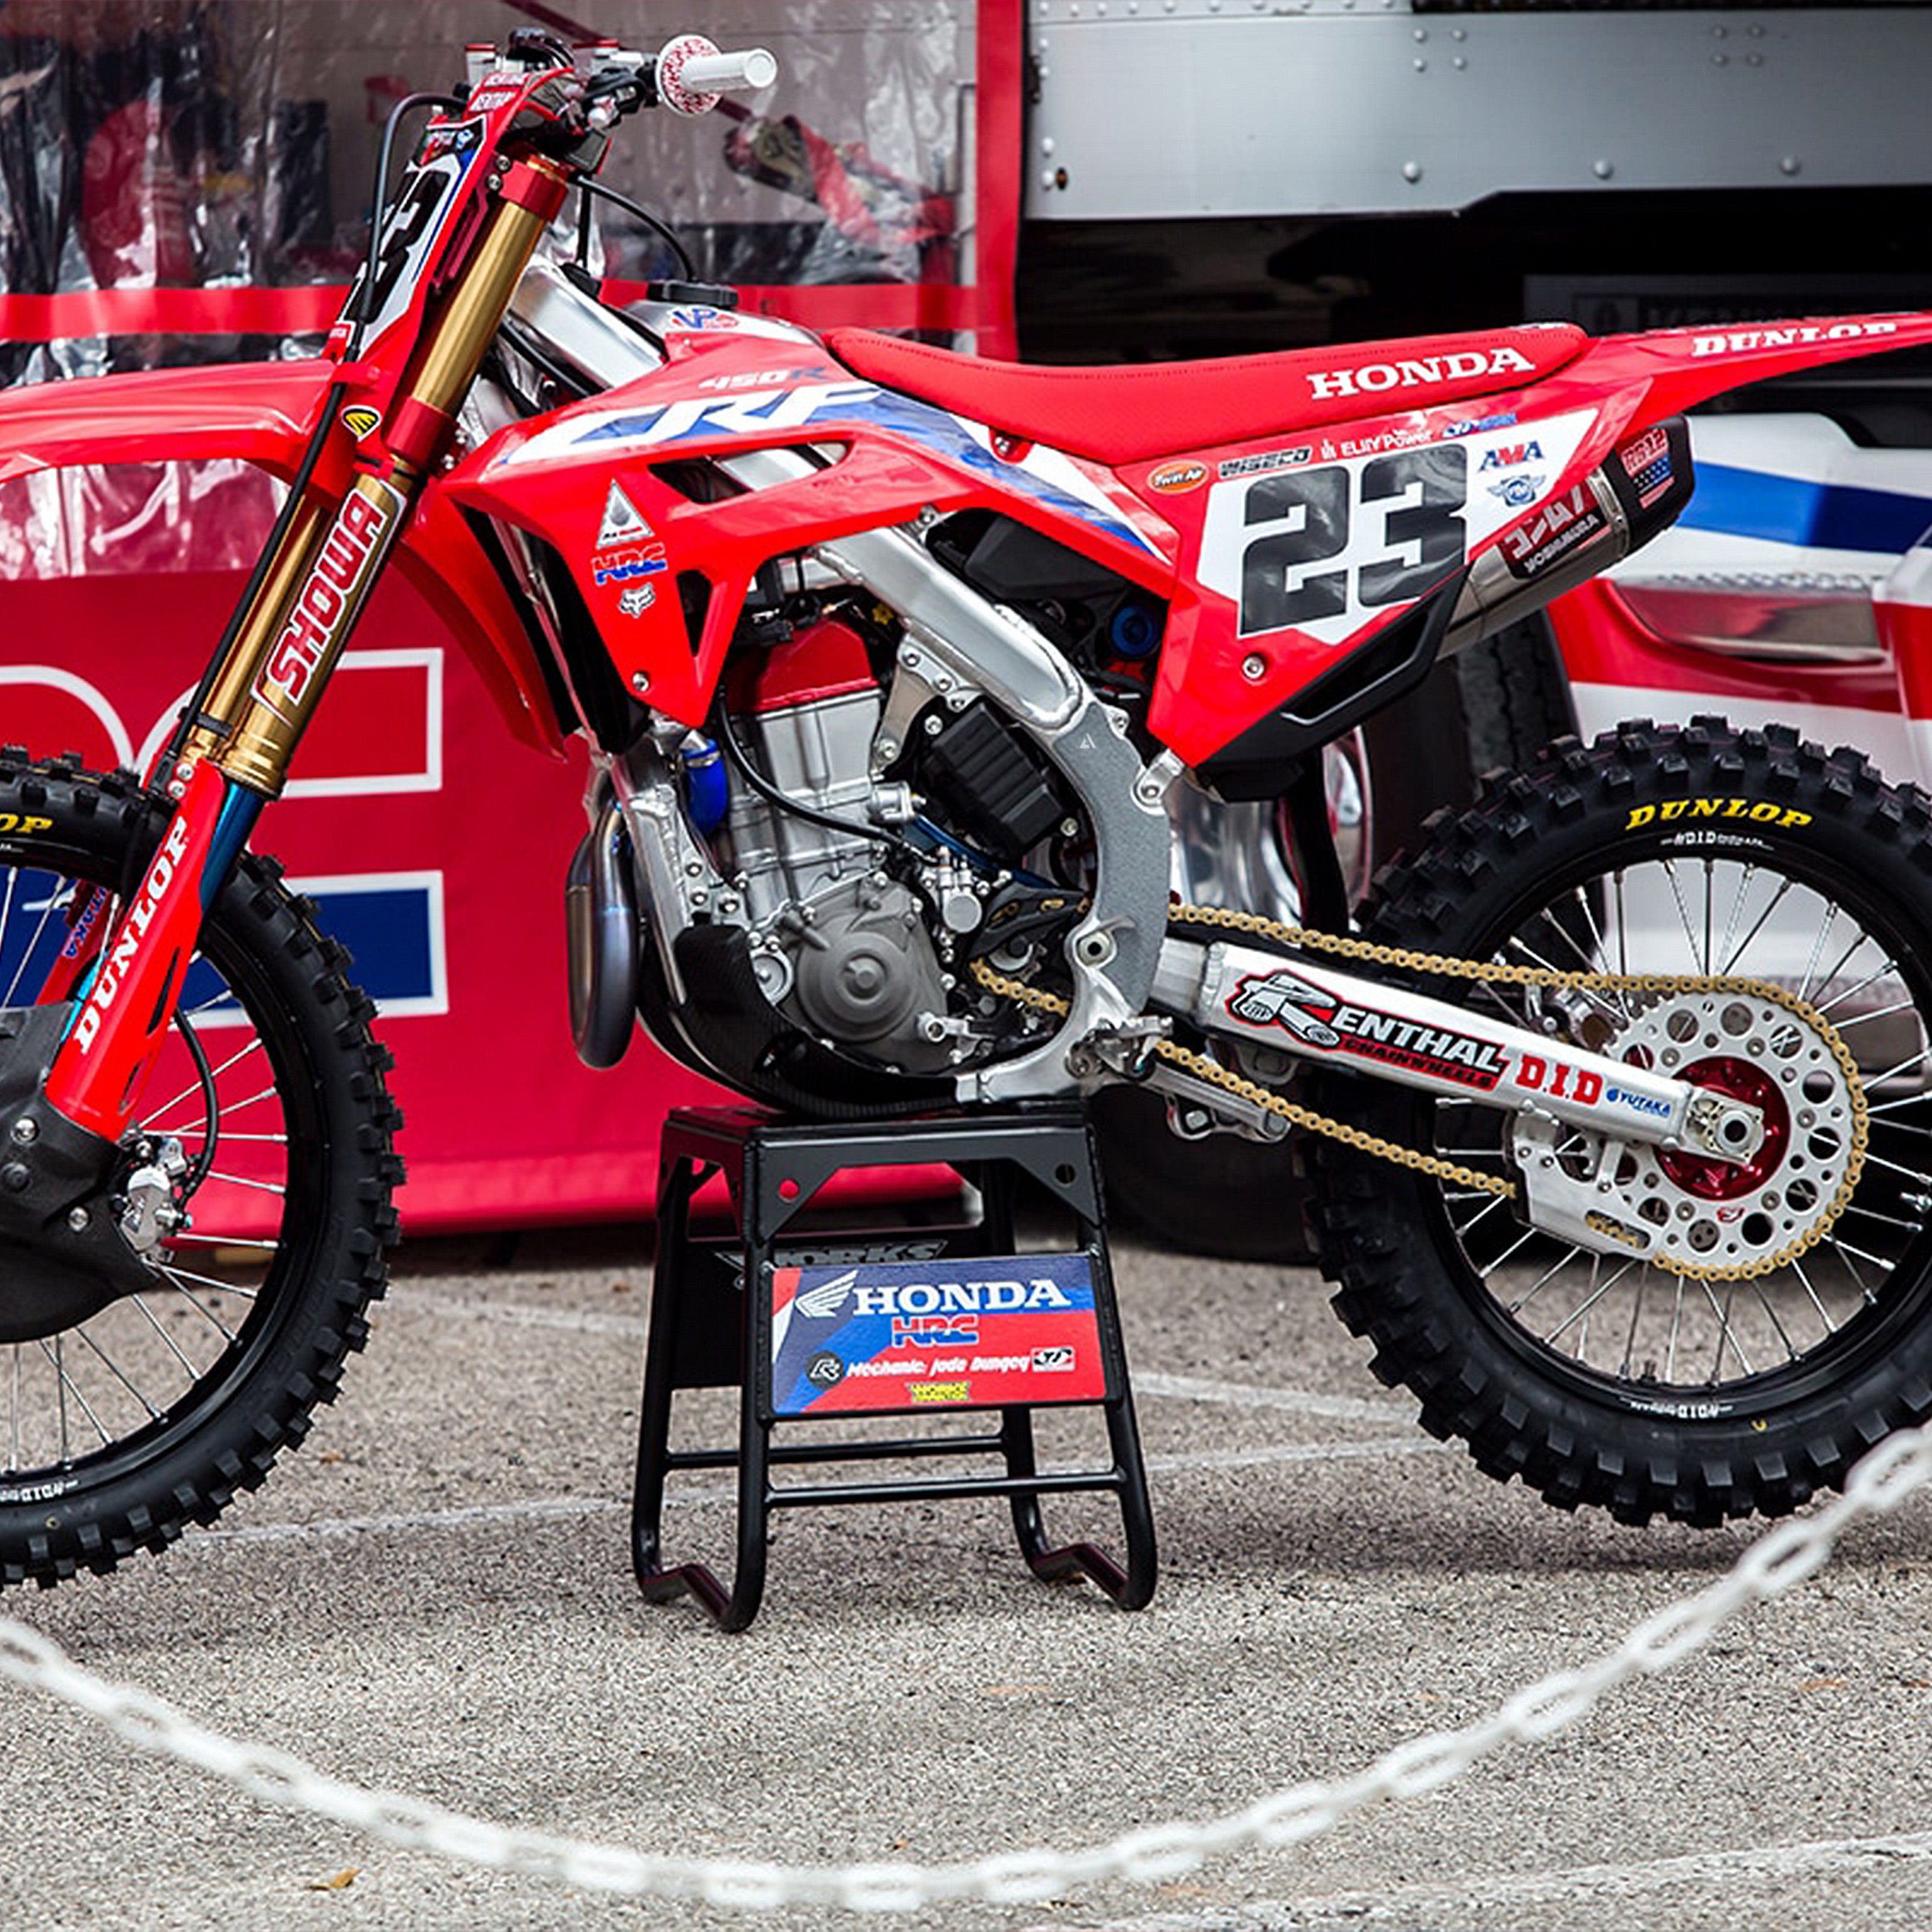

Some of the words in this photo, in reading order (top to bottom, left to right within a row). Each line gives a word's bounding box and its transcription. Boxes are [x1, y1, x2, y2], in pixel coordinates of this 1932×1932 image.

[1691, 322, 1896, 357] DUNLOP
[698, 368, 826, 390] 450R
[1307, 347, 1535, 399] HONDA
[1479, 440, 1544, 471] AMA
[1240, 444, 1467, 635] 23
[266, 488, 388, 705] SHOWA
[1625, 799, 1812, 830] DUNLOP
[73, 817, 188, 1054] DUNLOP
[1516, 1053, 1604, 1106] D.I.D
[852, 1279, 1071, 1315] HONDA
[892, 1314, 979, 1349] HRC
